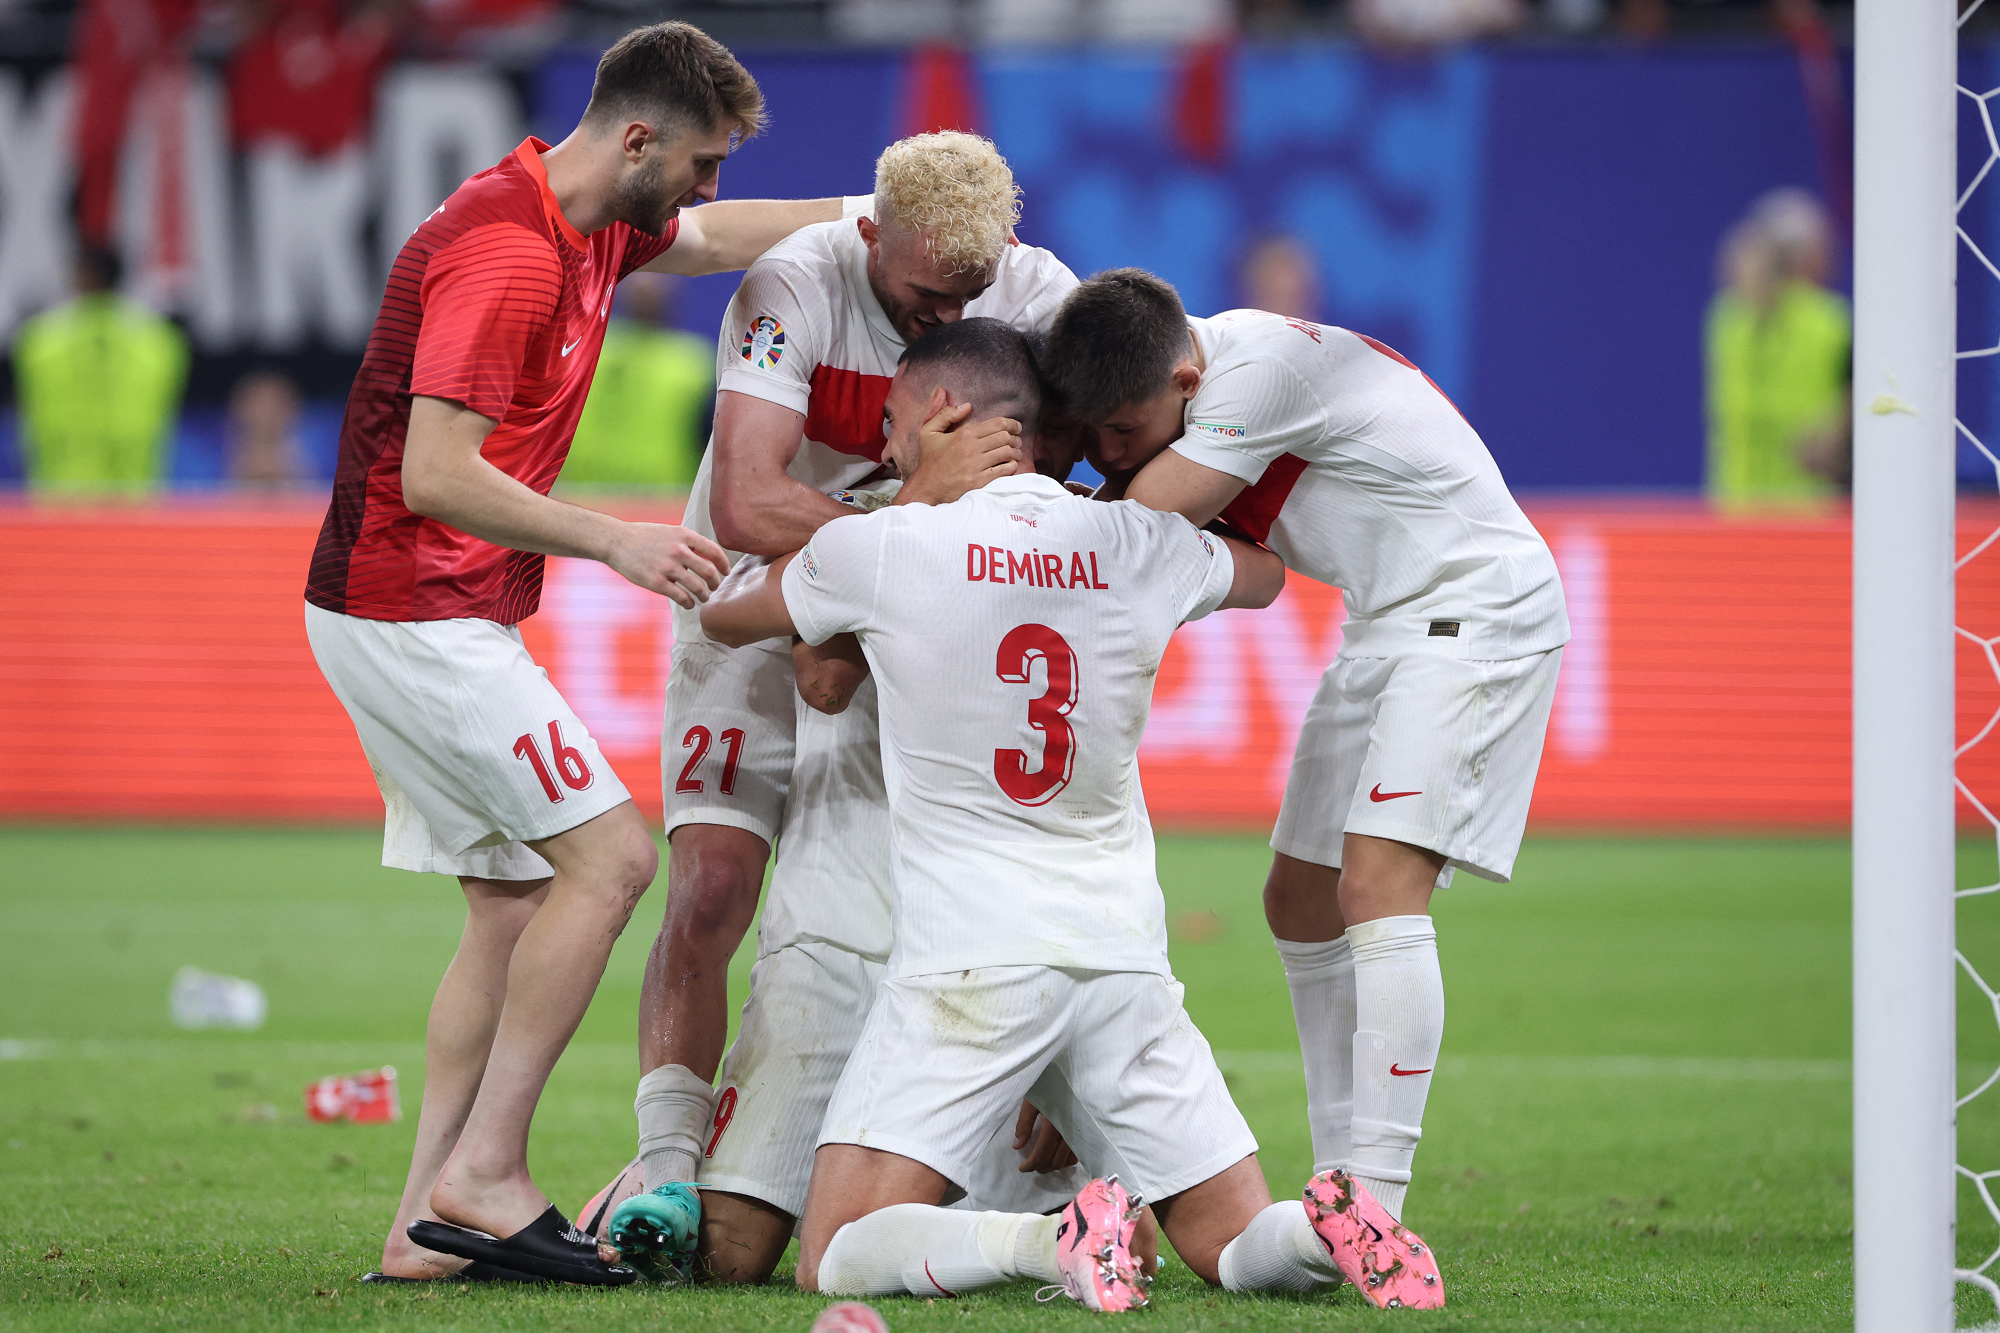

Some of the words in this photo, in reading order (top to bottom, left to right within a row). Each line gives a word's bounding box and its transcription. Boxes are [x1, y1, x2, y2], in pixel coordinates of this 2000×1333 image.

[967, 543, 1109, 590] DEMİRAL
[994, 623, 1079, 807] 3
[512, 719, 595, 804] 16
[675, 725, 746, 796] 21
[705, 1086, 738, 1158] 9
